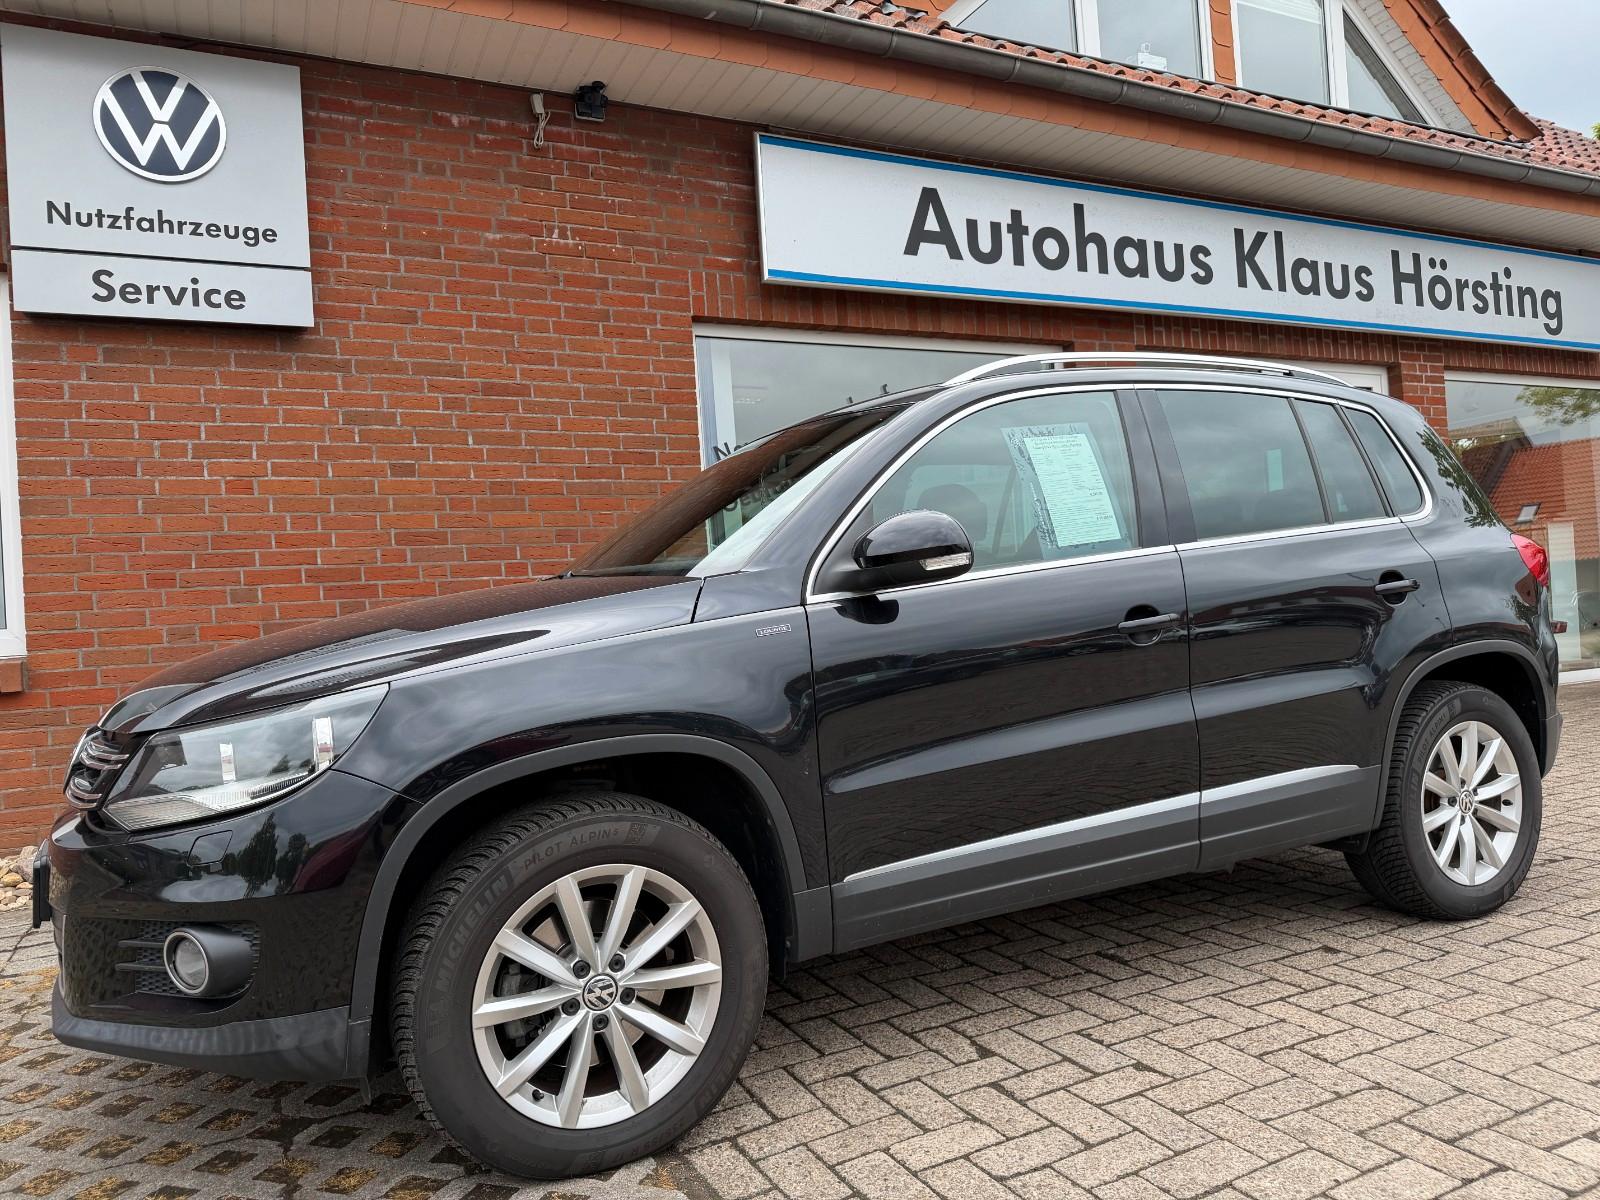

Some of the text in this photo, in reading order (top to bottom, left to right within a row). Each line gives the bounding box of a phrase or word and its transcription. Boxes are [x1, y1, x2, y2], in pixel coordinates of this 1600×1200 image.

[46, 200, 278, 247] Nutzfahrzeuge
[904, 187, 1563, 336] Autohaus Klaus Hörsting
[92, 269, 246, 311] Service
[435, 878, 510, 993] MICHELIN
[523, 840, 563, 871] PILOT
